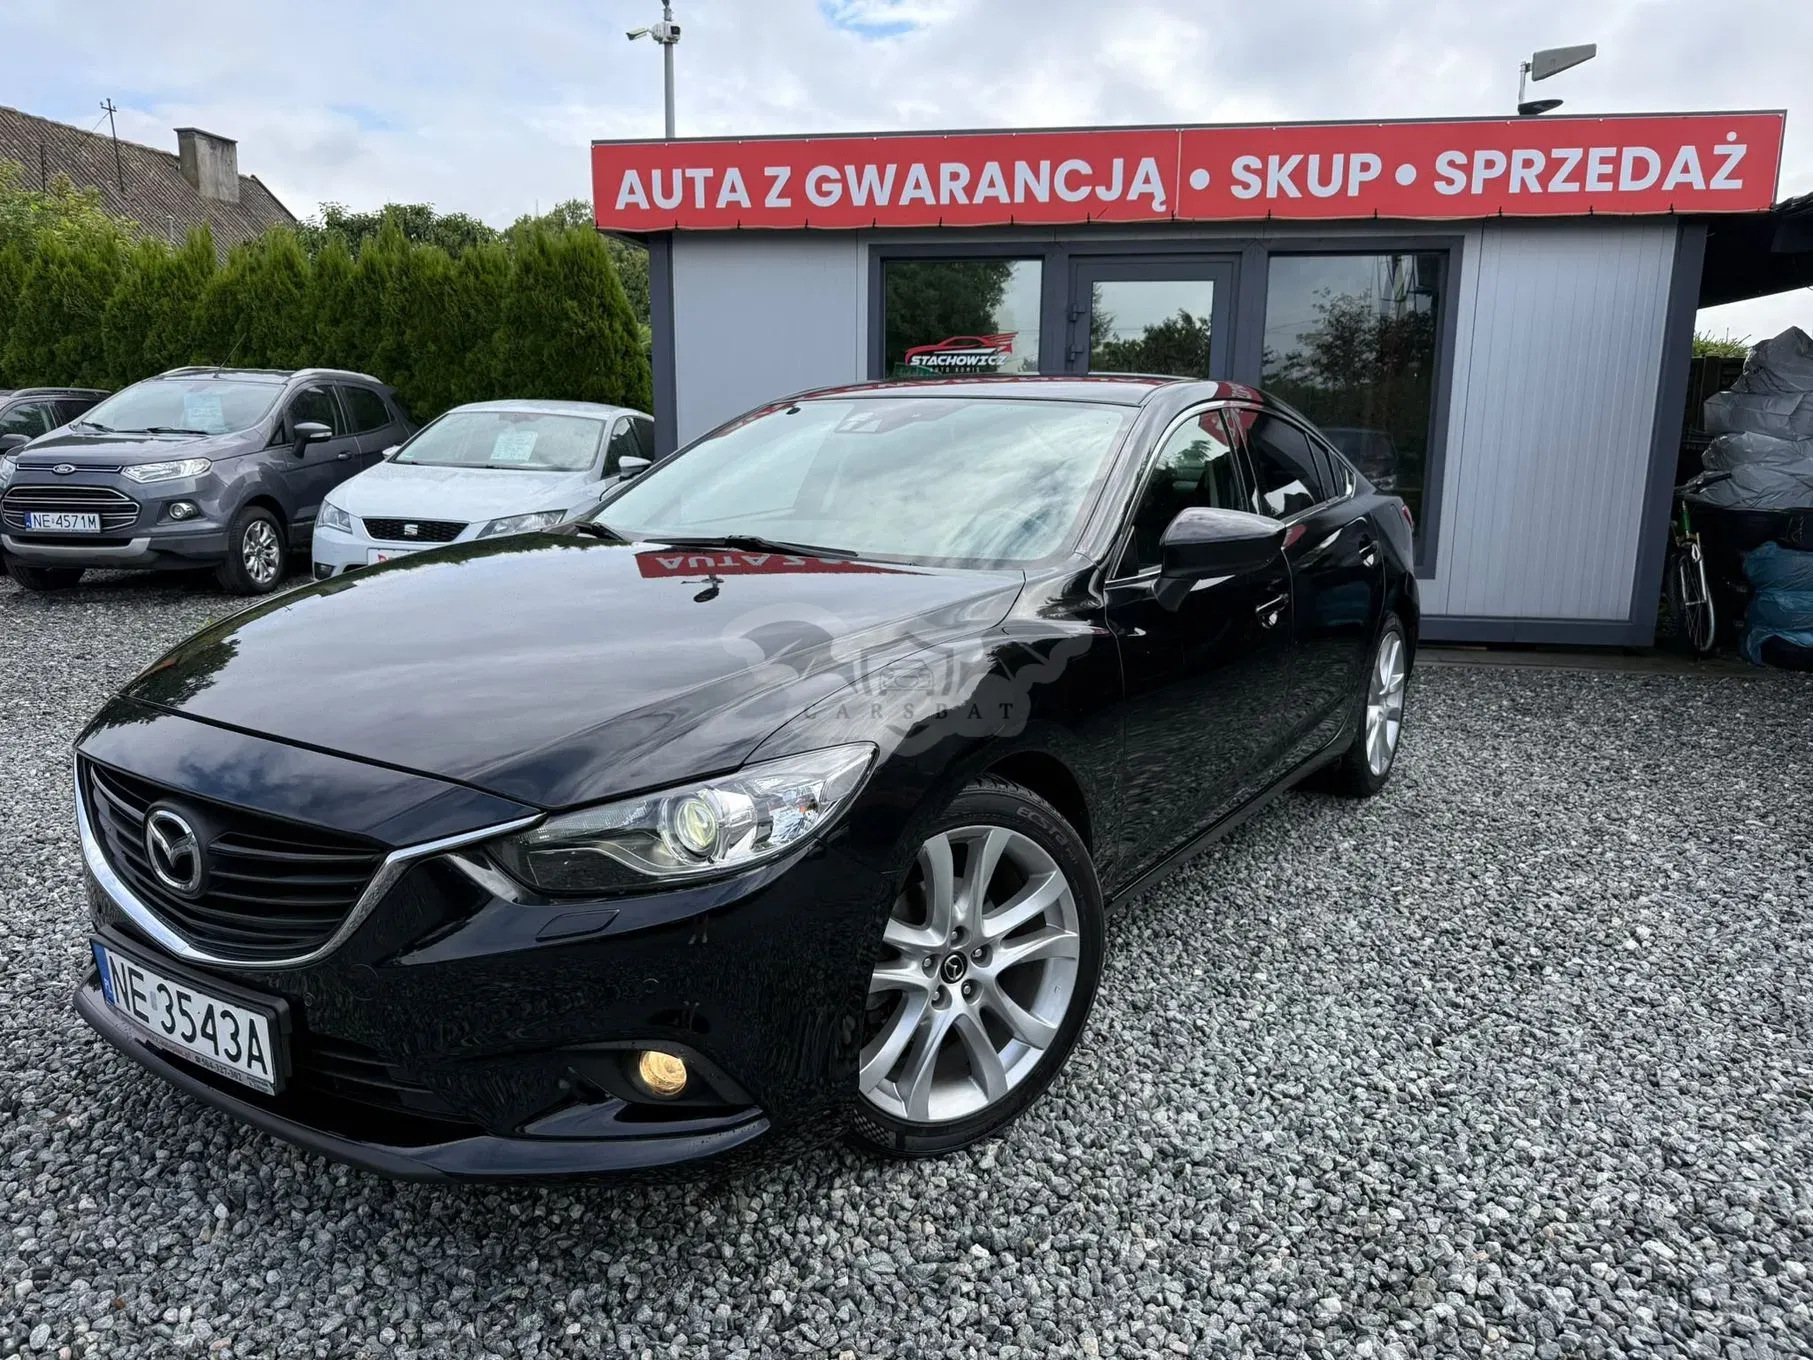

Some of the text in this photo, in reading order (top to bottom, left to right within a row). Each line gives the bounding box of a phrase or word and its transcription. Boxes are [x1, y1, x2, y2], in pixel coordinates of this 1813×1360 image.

[615, 131, 1747, 212] AUTA Z GWARANCJĄ SKUP SPRZEDAŻ
[910, 355, 1008, 366] STACHOWICZ
[33, 514, 97, 529] NE 4571M
[110, 955, 268, 1075] NE 3543A
